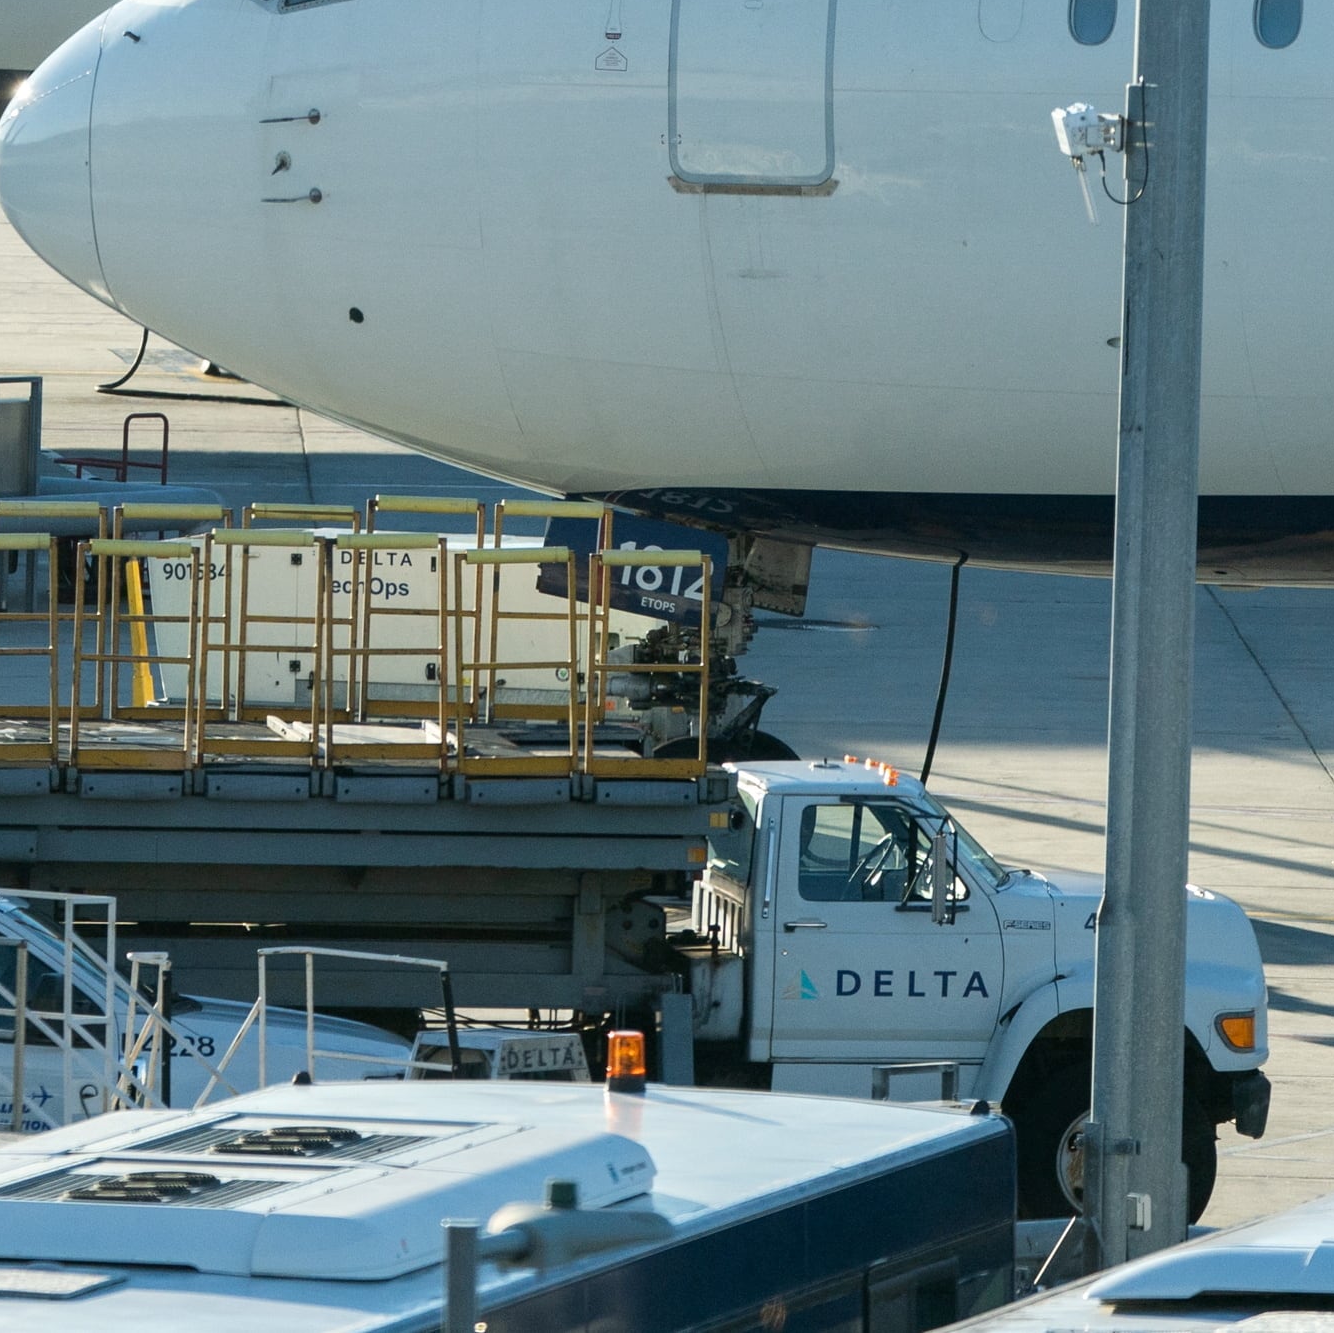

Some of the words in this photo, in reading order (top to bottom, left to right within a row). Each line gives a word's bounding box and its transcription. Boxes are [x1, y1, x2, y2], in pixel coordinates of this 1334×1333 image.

[340, 550, 413, 567] DELTA
[332, 577, 410, 600] ecOps
[640, 596, 676, 613] ETOPS
[836, 969, 990, 999] DELTA
[507, 1047, 576, 1069] DELTA
